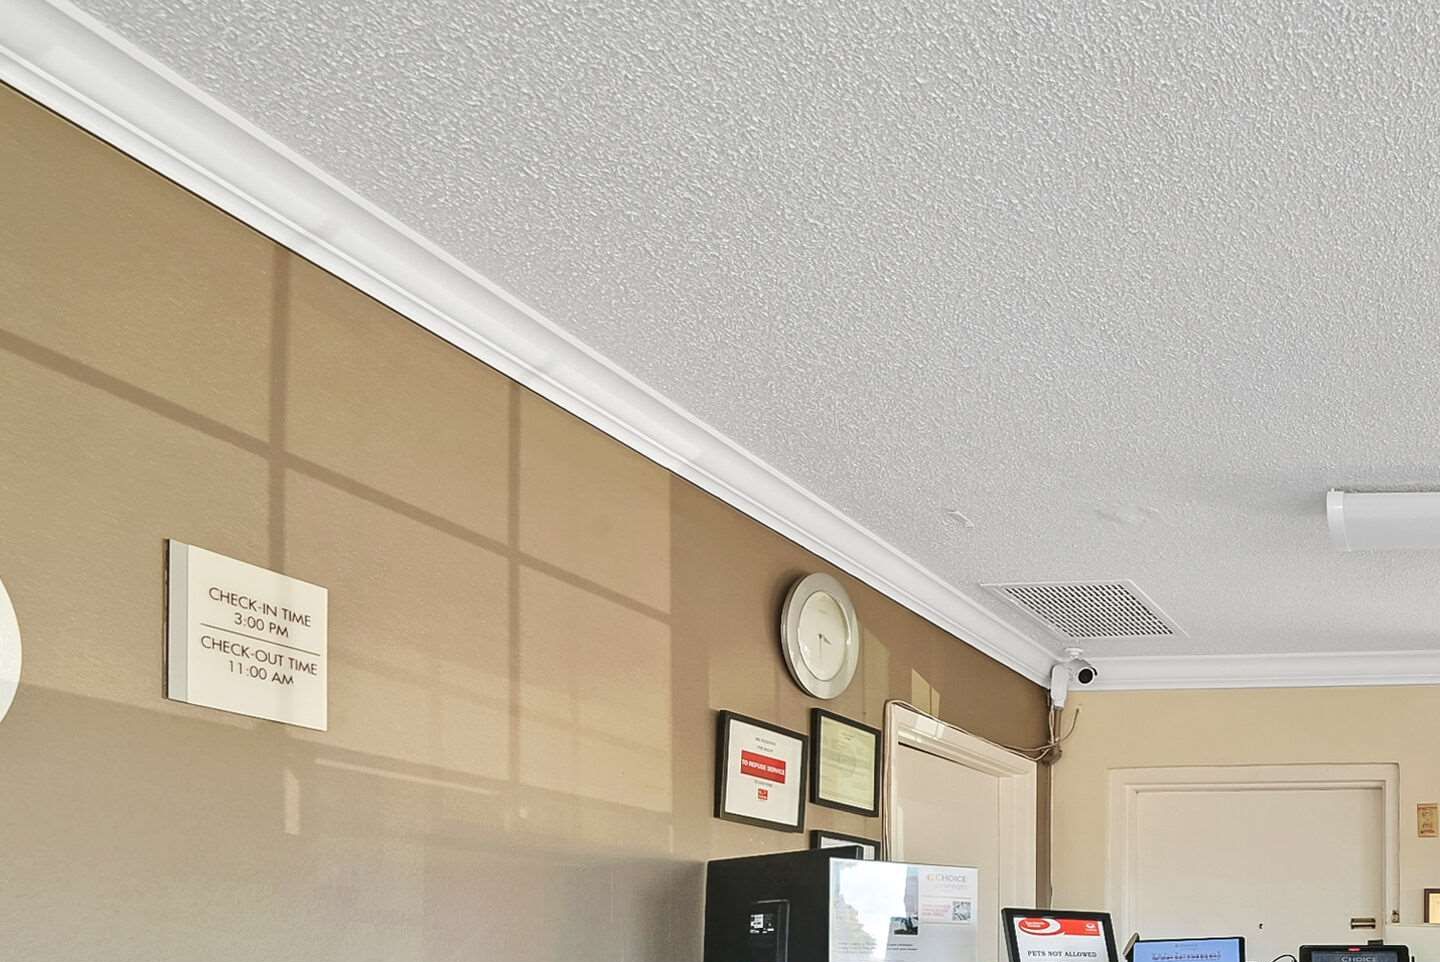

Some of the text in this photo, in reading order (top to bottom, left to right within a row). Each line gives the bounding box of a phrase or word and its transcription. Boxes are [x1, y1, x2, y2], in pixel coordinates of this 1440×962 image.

[208, 587, 312, 628] CHECK-IN TIME
[234, 611, 289, 638] 3:00 PM
[201, 635, 318, 676] CHECK-OUT TIME
[229, 659, 294, 685] 11:00 AM
[1027, 950, 1097, 959] PETS NOT ALLOWED
